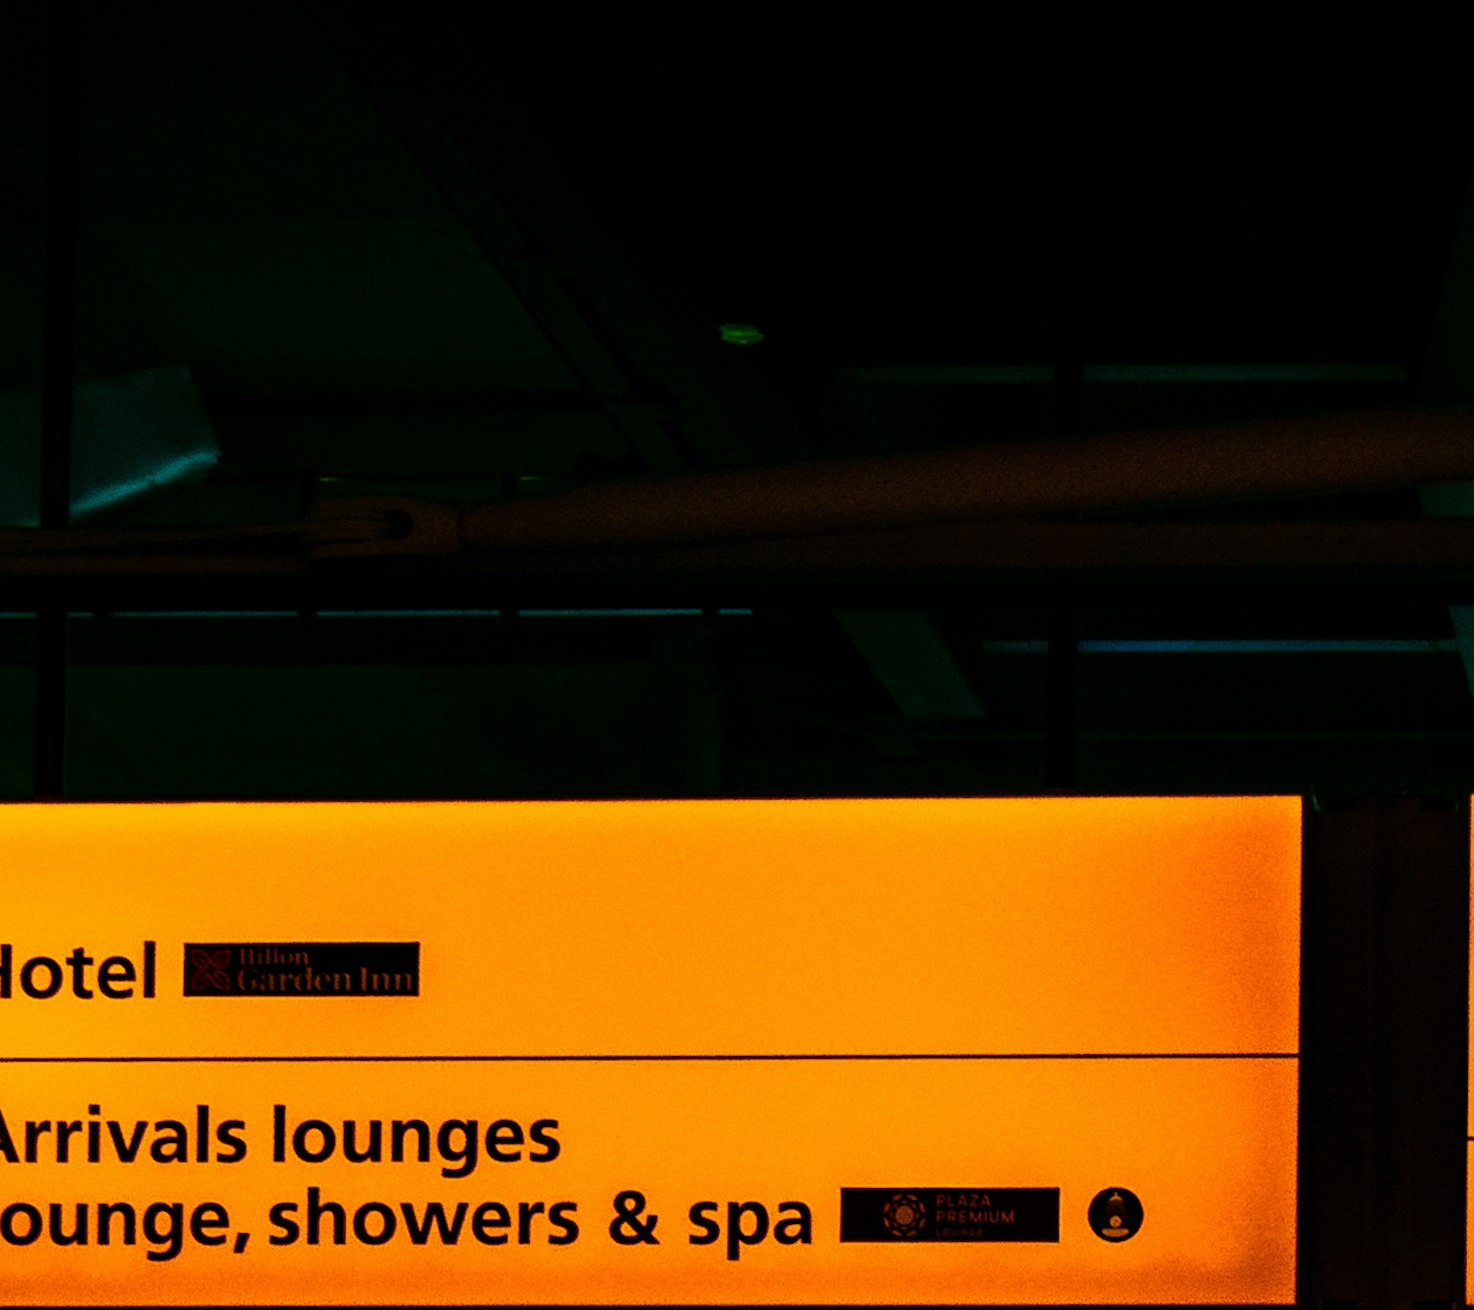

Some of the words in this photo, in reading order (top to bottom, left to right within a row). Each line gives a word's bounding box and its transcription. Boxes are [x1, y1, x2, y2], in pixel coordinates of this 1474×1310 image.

[237, 946, 311, 966] Hilton
[235, 964, 354, 992] Garden
[357, 964, 415, 992] Inn
[273, 1104, 560, 1179] lounges
[935, 1193, 992, 1208] PLAZA
[269, 1186, 579, 1246] showers
[609, 1190, 659, 1246] &
[689, 1201, 812, 1261] spa
[935, 1209, 1016, 1224] PREMIUM
